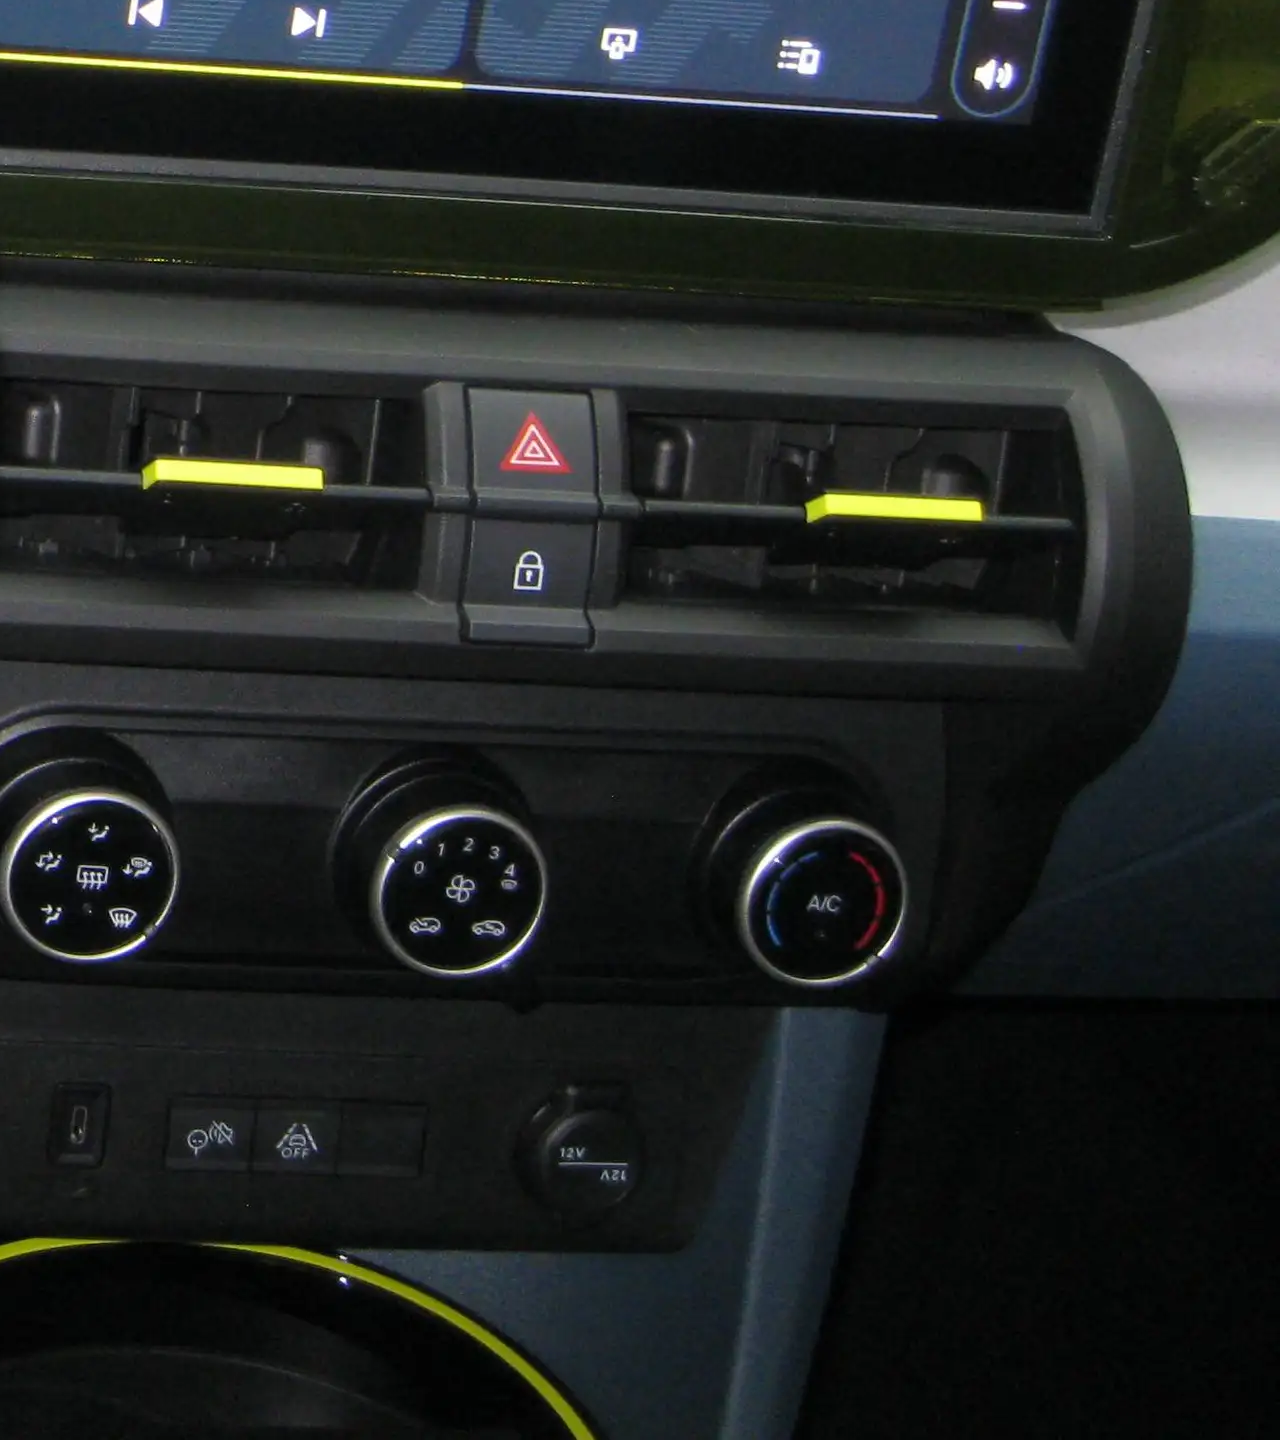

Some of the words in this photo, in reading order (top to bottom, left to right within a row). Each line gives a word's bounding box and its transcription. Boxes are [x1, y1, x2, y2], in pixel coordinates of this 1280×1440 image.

[413, 860, 425, 875] 0
[437, 843, 445, 857] 1
[462, 837, 474, 852] 2
[489, 845, 500, 860] 3
[504, 863, 516, 877] 4
[806, 894, 842, 913] A/C
[281, 1147, 310, 1160] OFF
[559, 1147, 586, 1159] 12V
[600, 1169, 627, 1181] 12V
